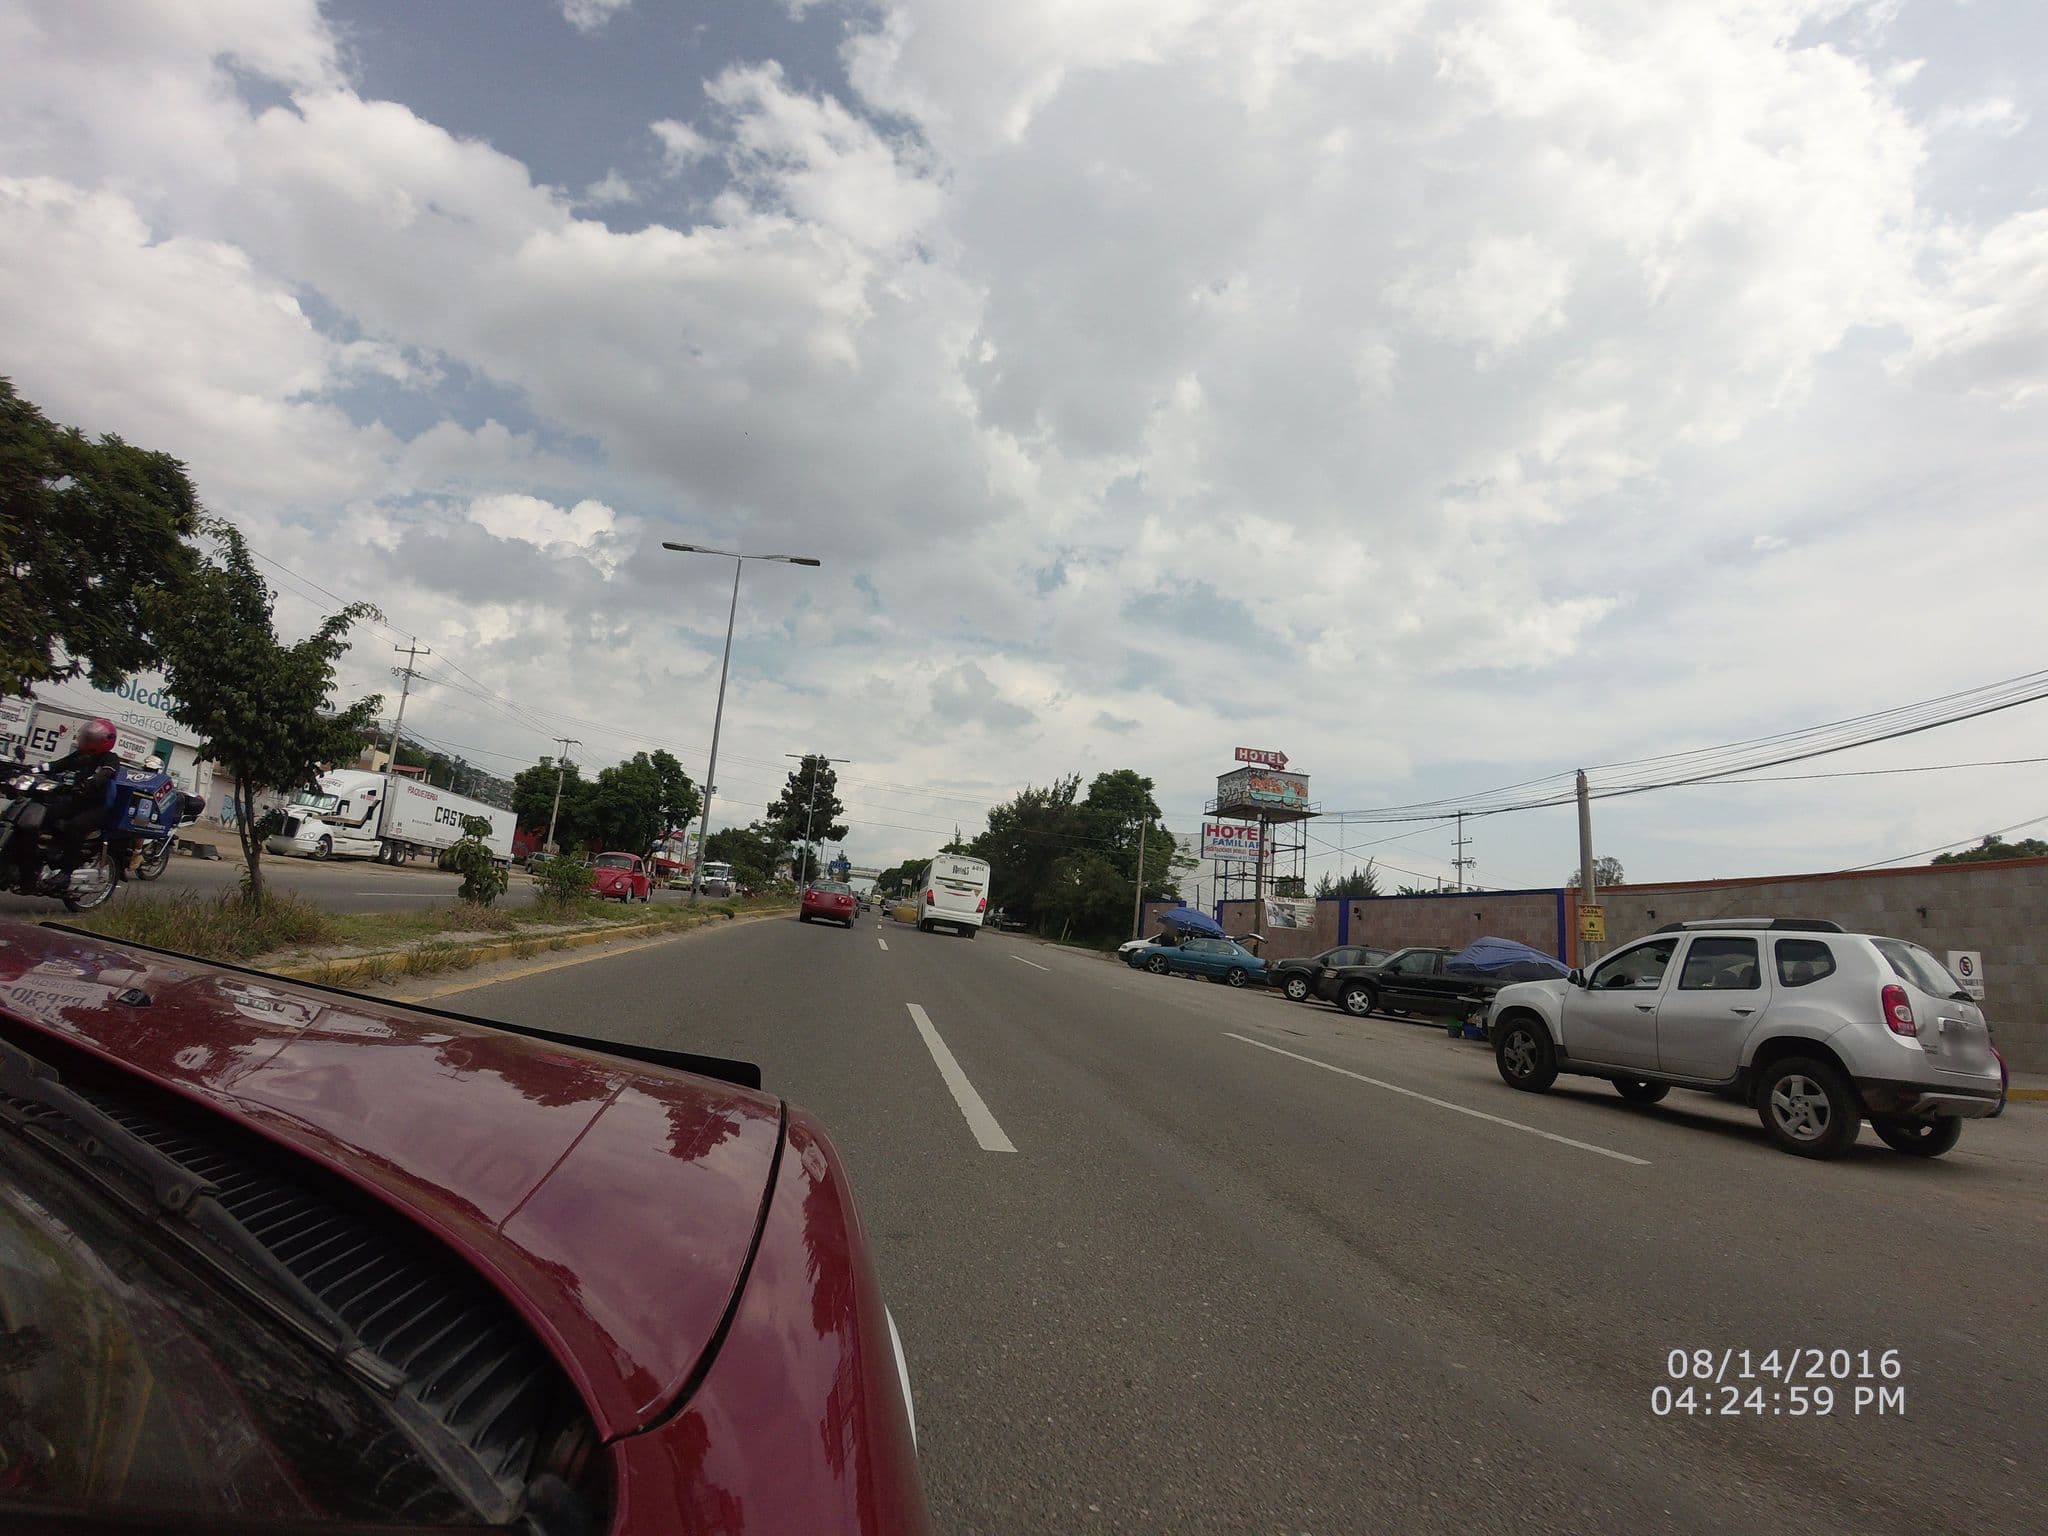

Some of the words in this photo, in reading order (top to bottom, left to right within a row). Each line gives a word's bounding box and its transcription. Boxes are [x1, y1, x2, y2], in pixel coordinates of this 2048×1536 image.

[121, 711, 180, 737] abarrotes
[118, 738, 145, 754] CASTORES
[1240, 748, 1284, 764] HOTEL
